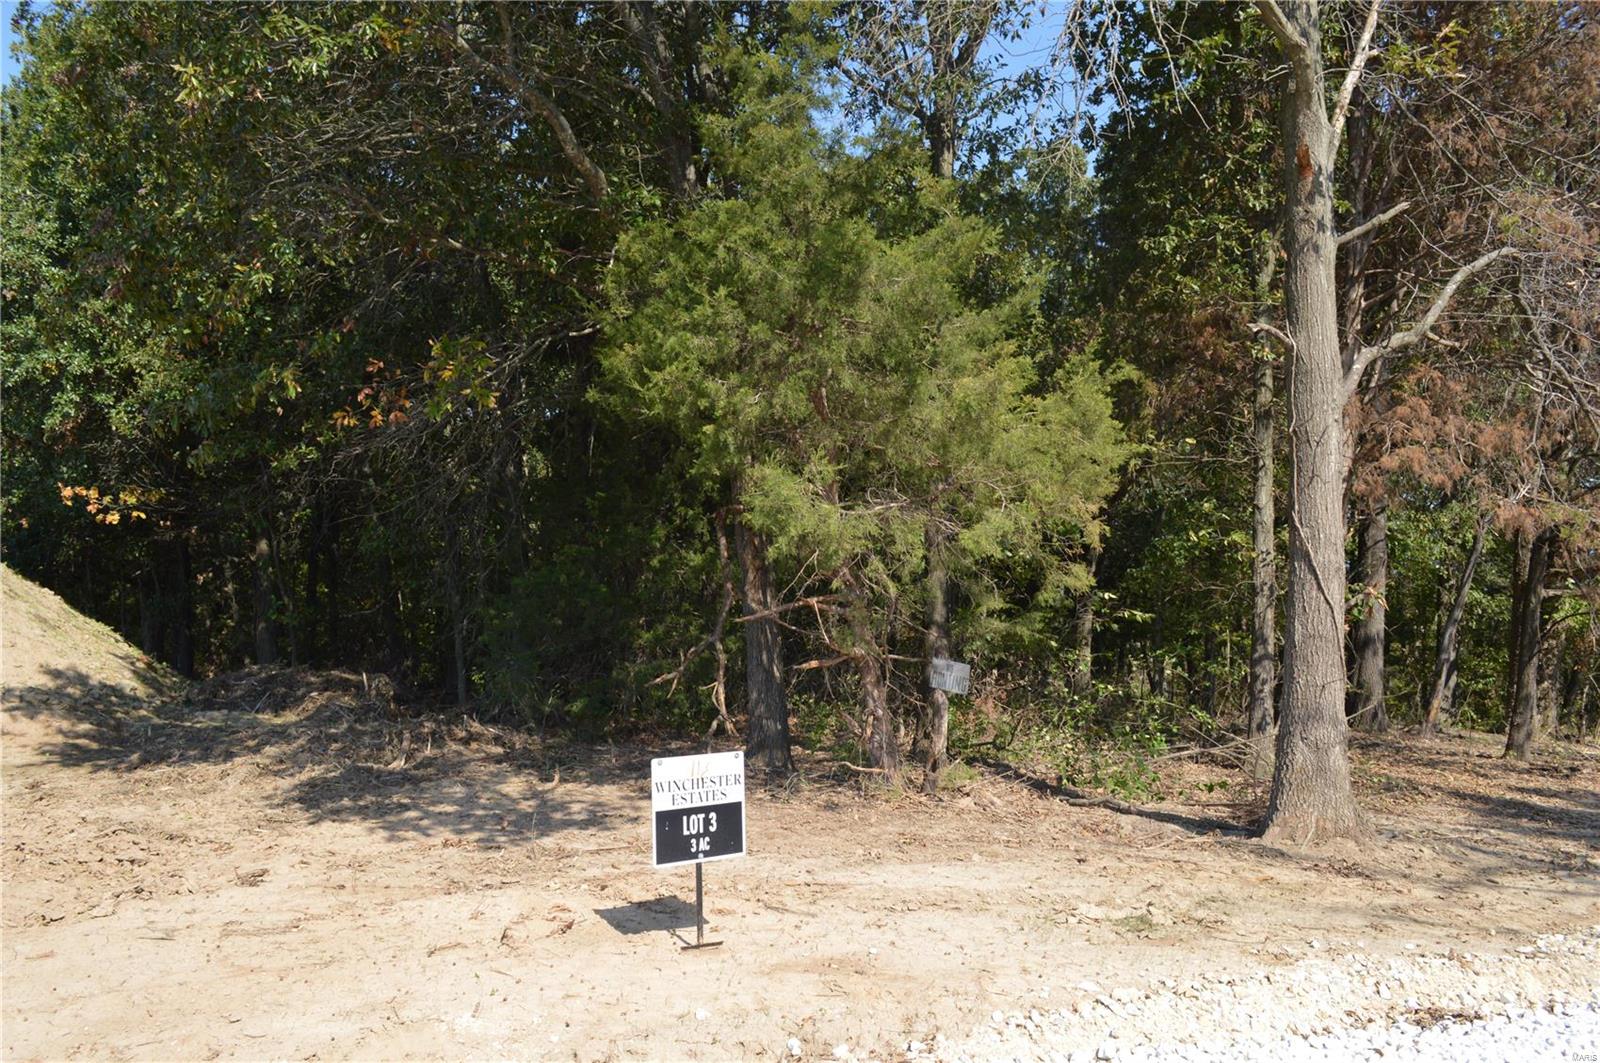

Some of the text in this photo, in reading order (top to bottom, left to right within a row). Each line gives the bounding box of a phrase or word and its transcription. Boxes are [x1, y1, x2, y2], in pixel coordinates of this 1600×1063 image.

[655, 773, 742, 793] WINCHESTER
[671, 789, 727, 806] ESTATES
[682, 811, 718, 836] LOT 3
[690, 836, 711, 853] 3 AC
